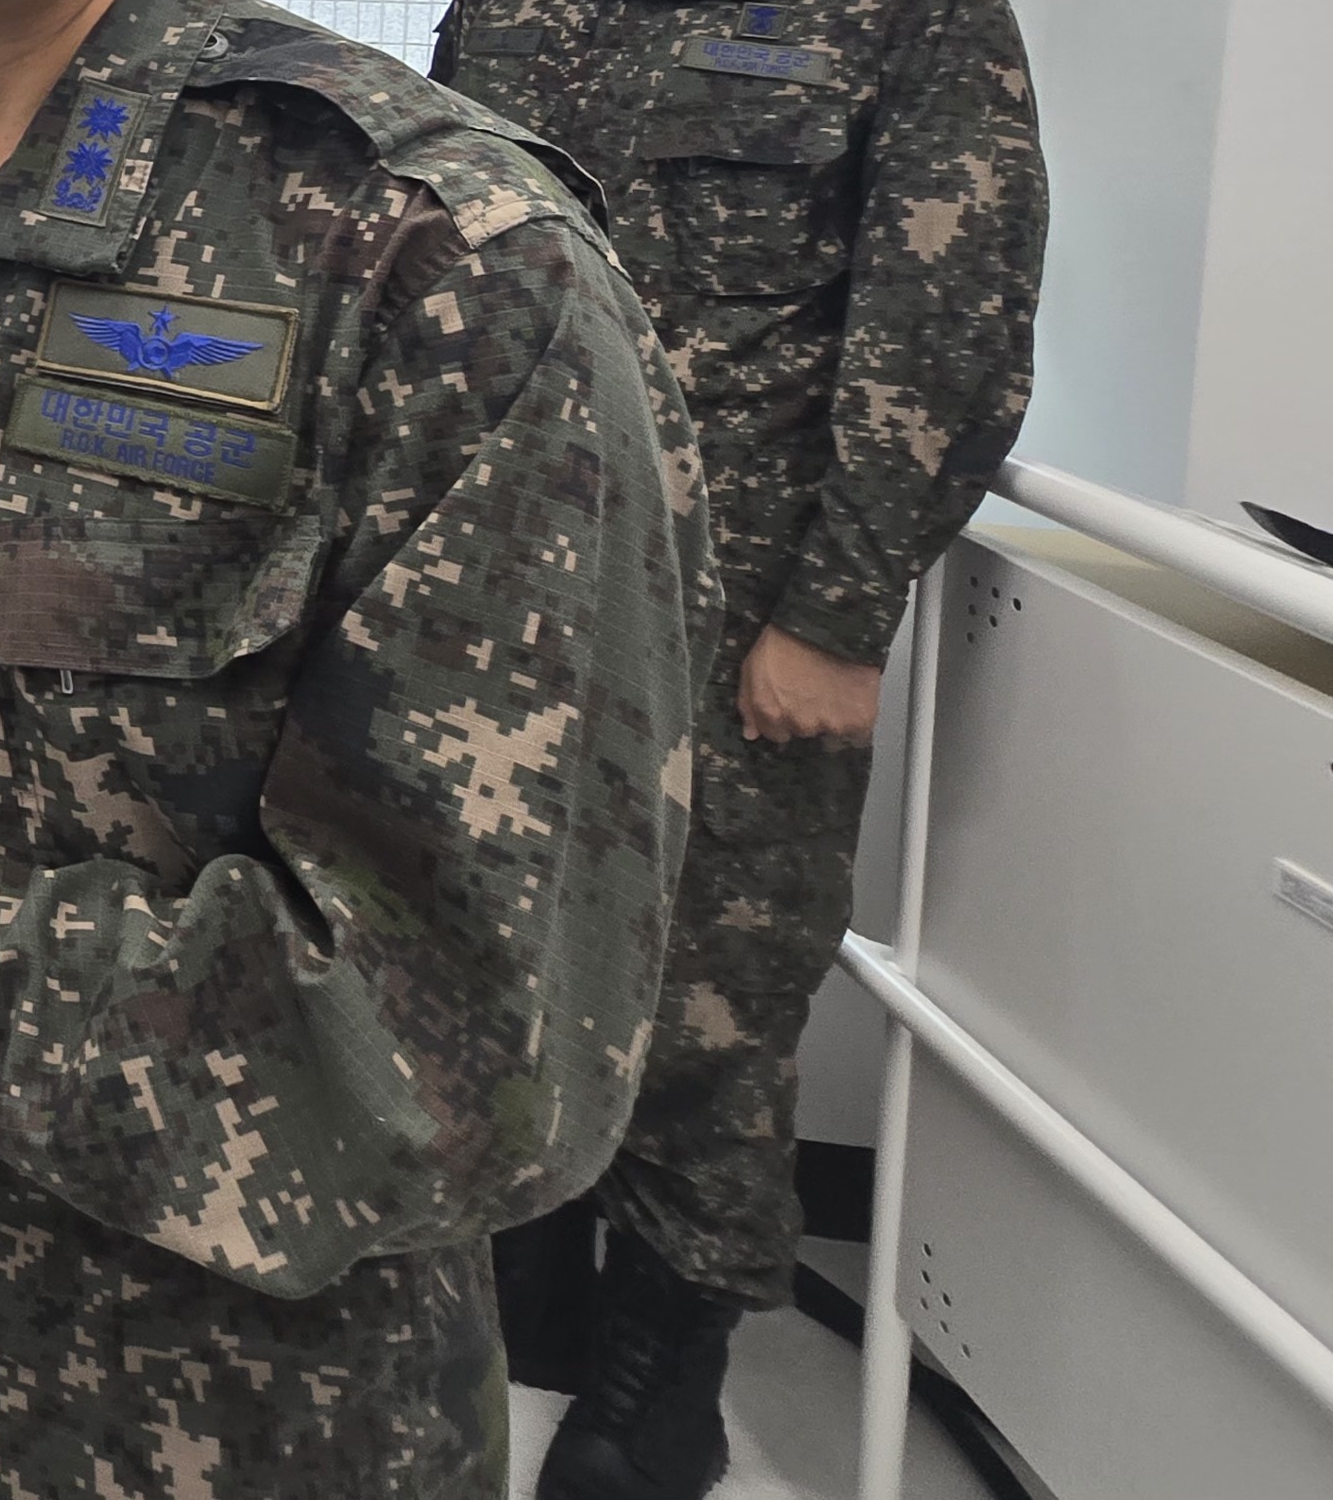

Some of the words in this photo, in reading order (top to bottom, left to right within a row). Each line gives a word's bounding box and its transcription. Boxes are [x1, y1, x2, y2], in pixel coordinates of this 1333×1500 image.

[41, 389, 169, 447] 대한민국
[183, 420, 256, 469] 공군
[116, 442, 147, 469] AIR
[152, 450, 216, 484] FORCE
